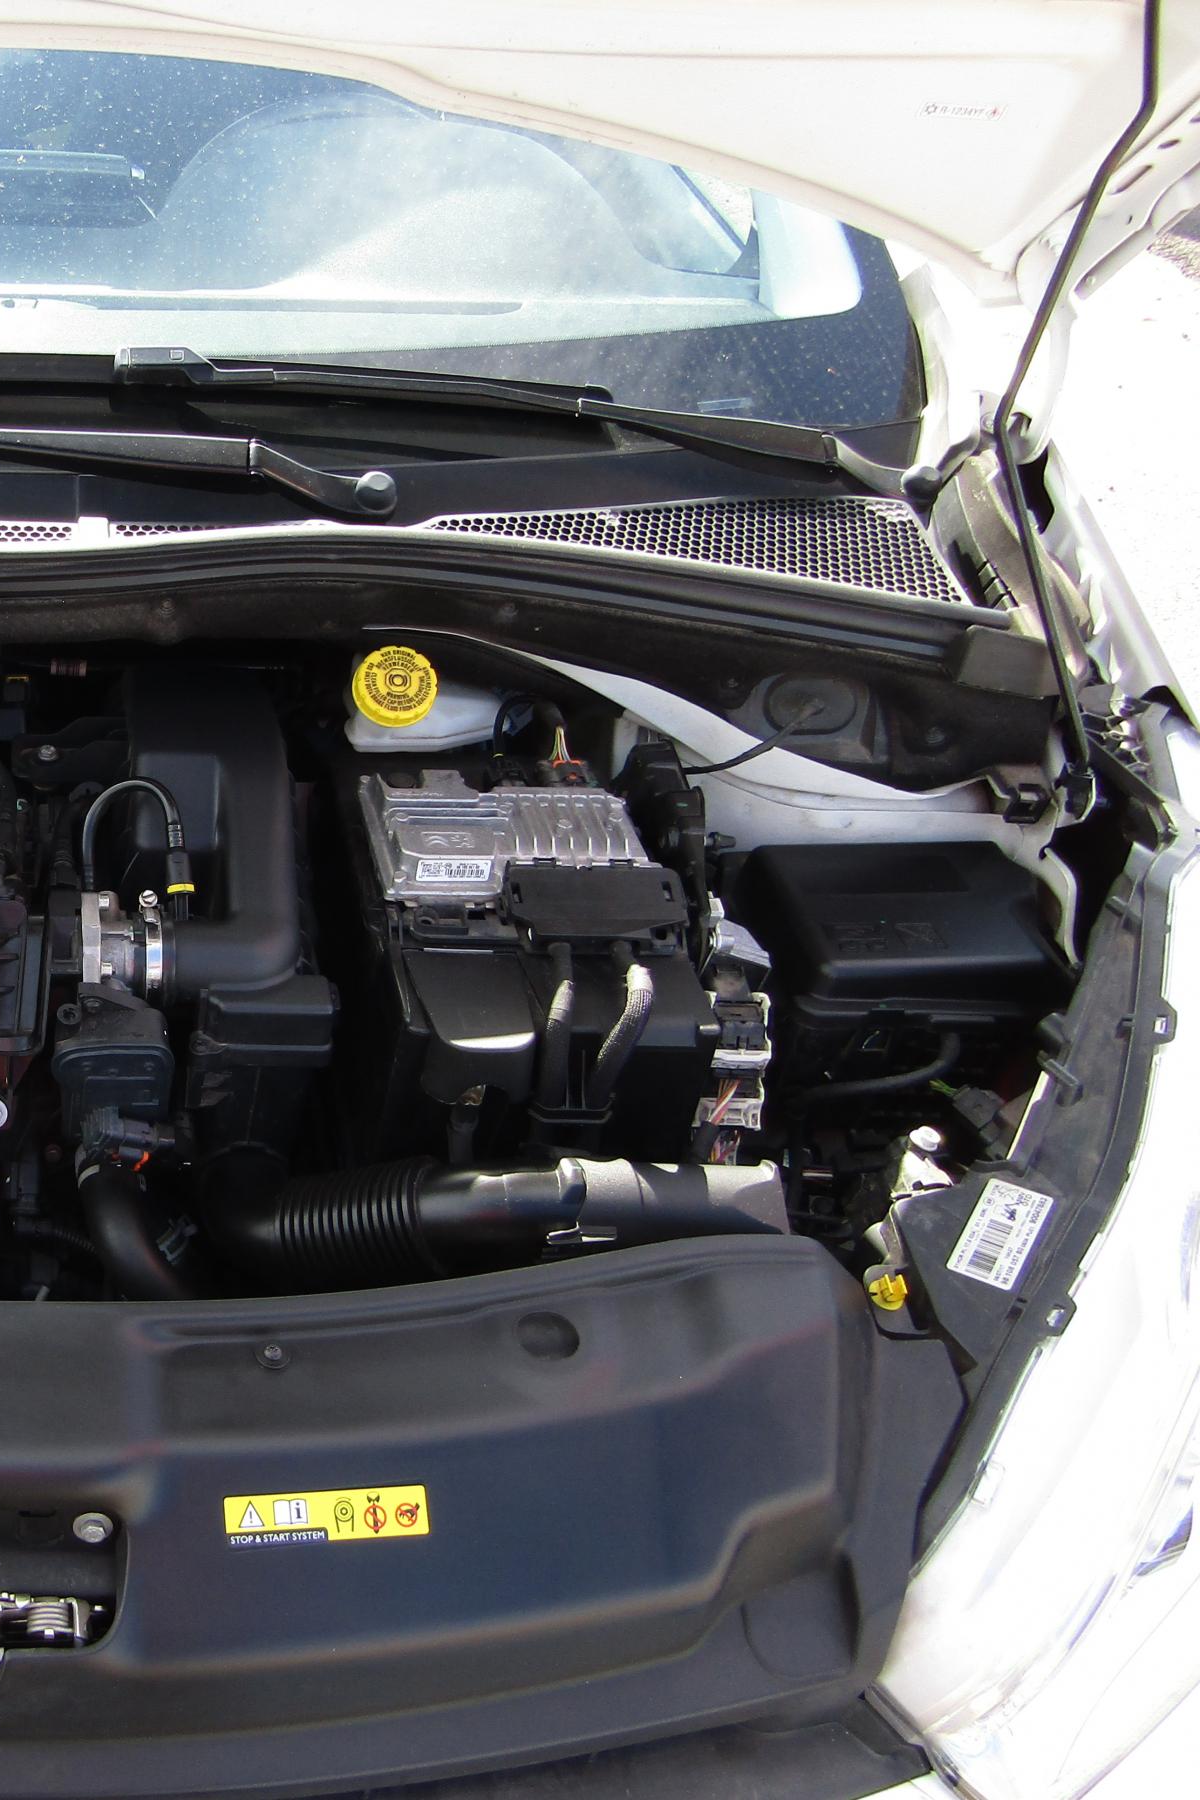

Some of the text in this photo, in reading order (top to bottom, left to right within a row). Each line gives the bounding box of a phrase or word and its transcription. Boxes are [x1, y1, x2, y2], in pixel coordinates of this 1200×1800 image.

[230, 1531, 325, 1545] STOP & START SYSTEM
